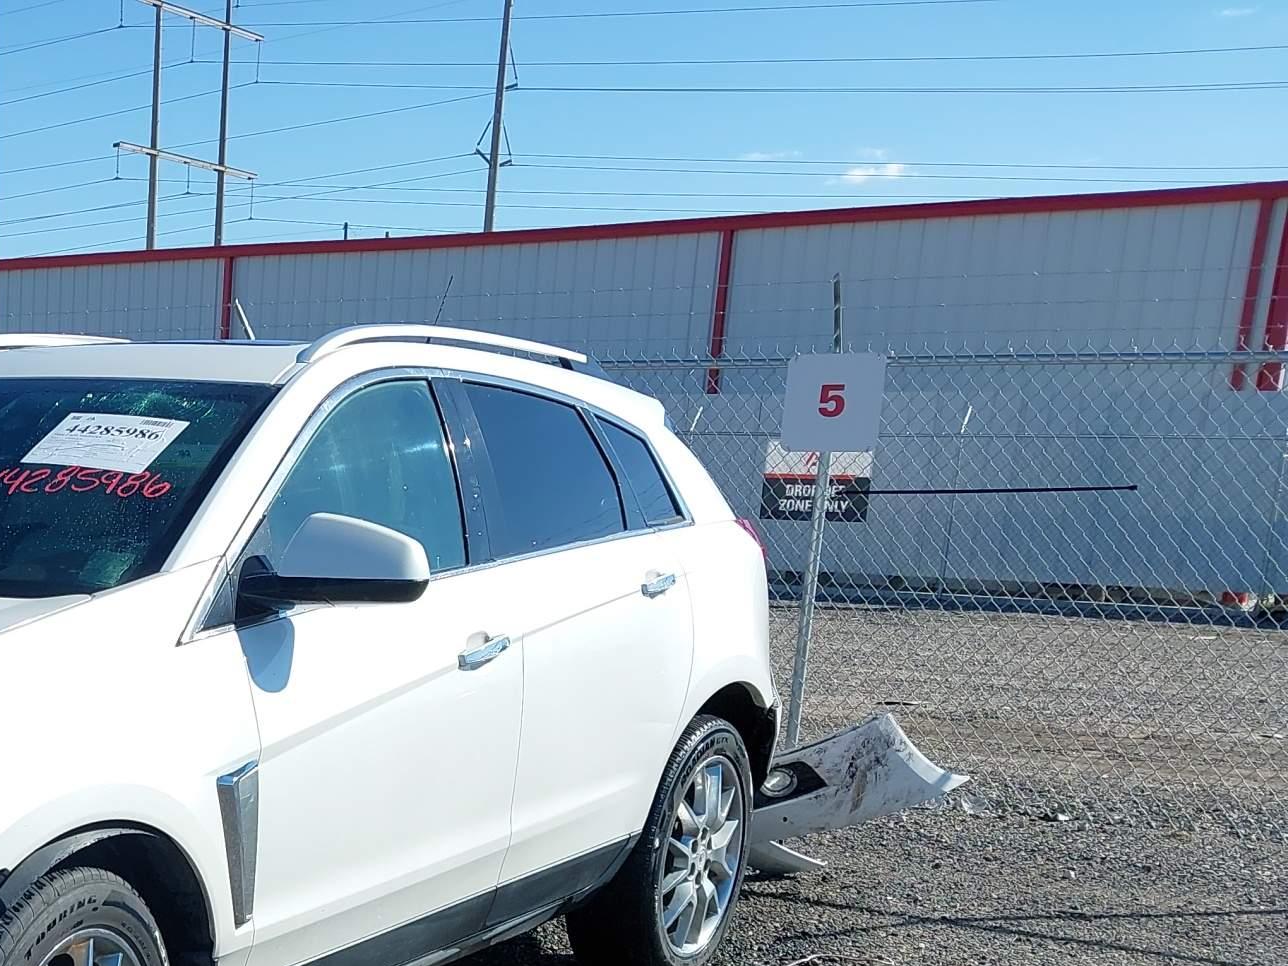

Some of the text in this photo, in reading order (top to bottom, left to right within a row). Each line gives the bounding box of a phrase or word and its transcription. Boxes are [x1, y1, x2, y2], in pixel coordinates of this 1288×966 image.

[817, 383, 846, 418] 5
[65, 423, 162, 441] 44285986
[777, 499, 850, 514] ZONE NLY
[23, 894, 97, 961] TOURING
